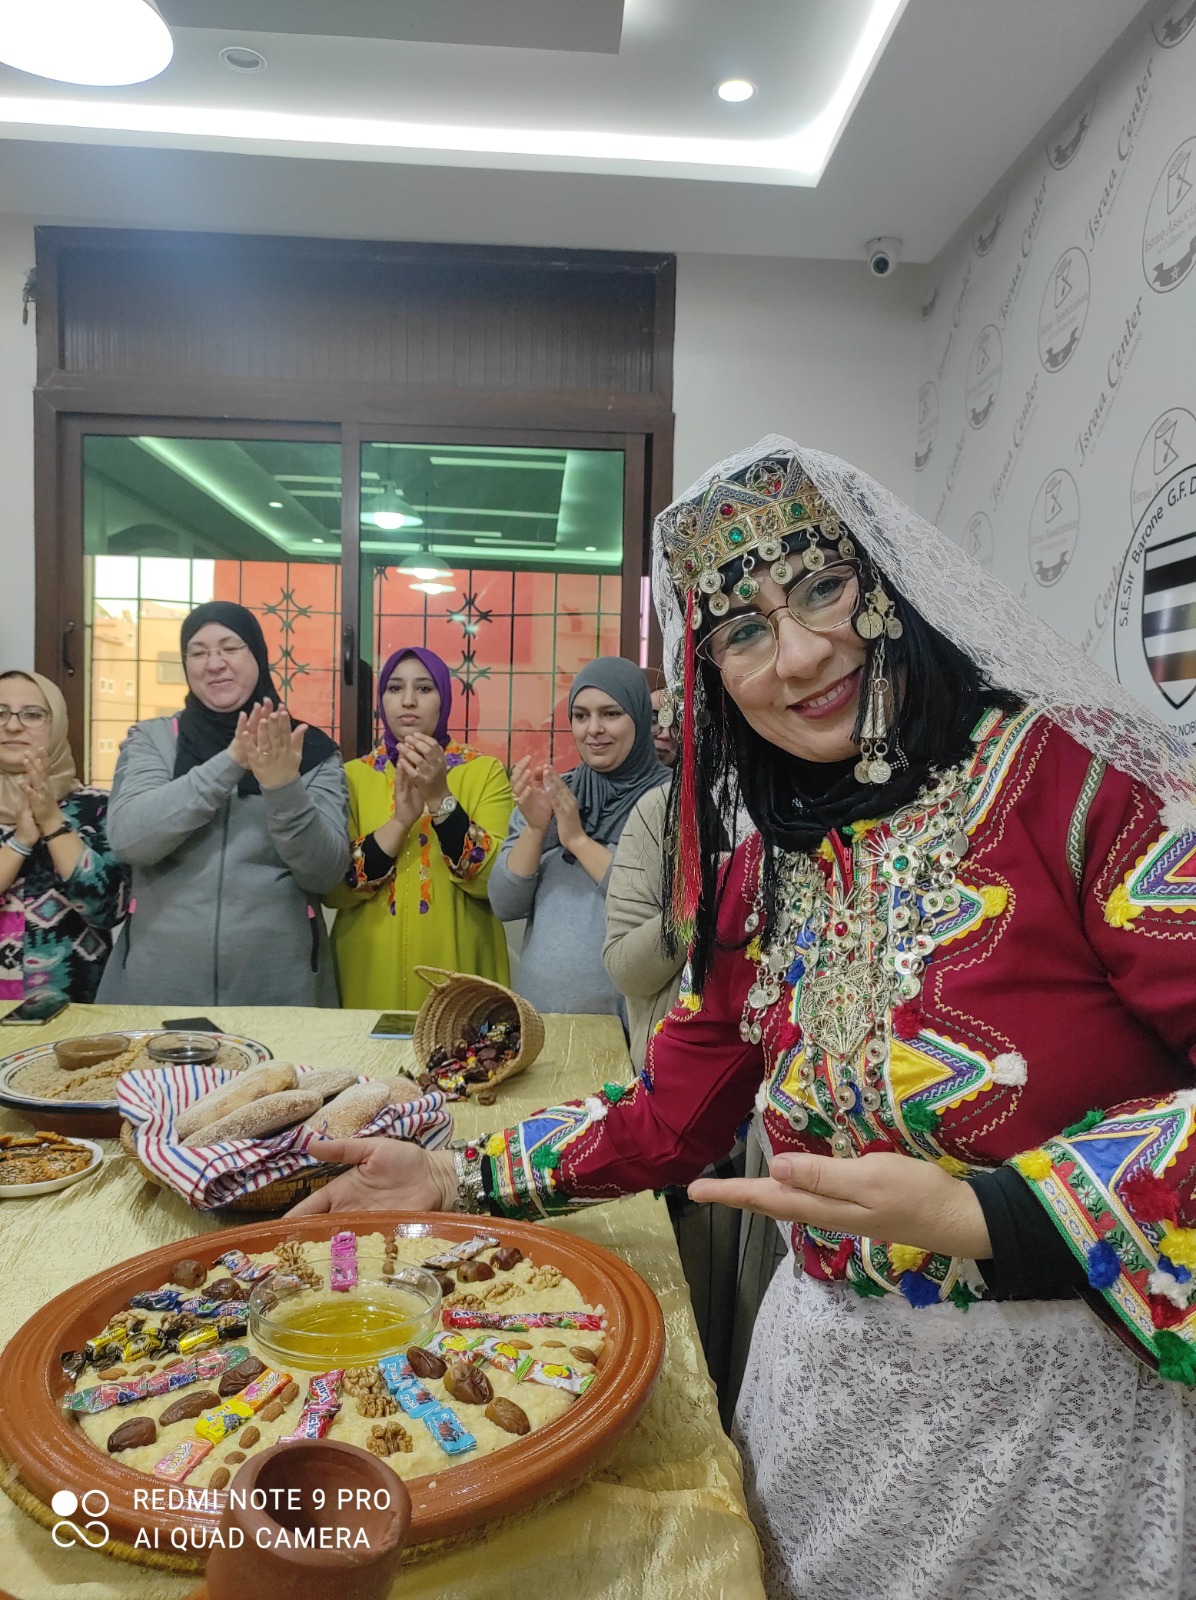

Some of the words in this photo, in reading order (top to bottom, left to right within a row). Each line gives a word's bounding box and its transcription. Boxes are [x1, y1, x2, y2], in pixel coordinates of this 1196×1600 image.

[1084, 168, 1117, 252] Israa
[1117, 58, 1152, 162] Center
[1021, 175, 1046, 259] Center
[1013, 372, 1038, 448] Center
[1075, 392, 1107, 468] Israa
[1108, 296, 1142, 389] Center
[1131, 506, 1164, 564] Barone
